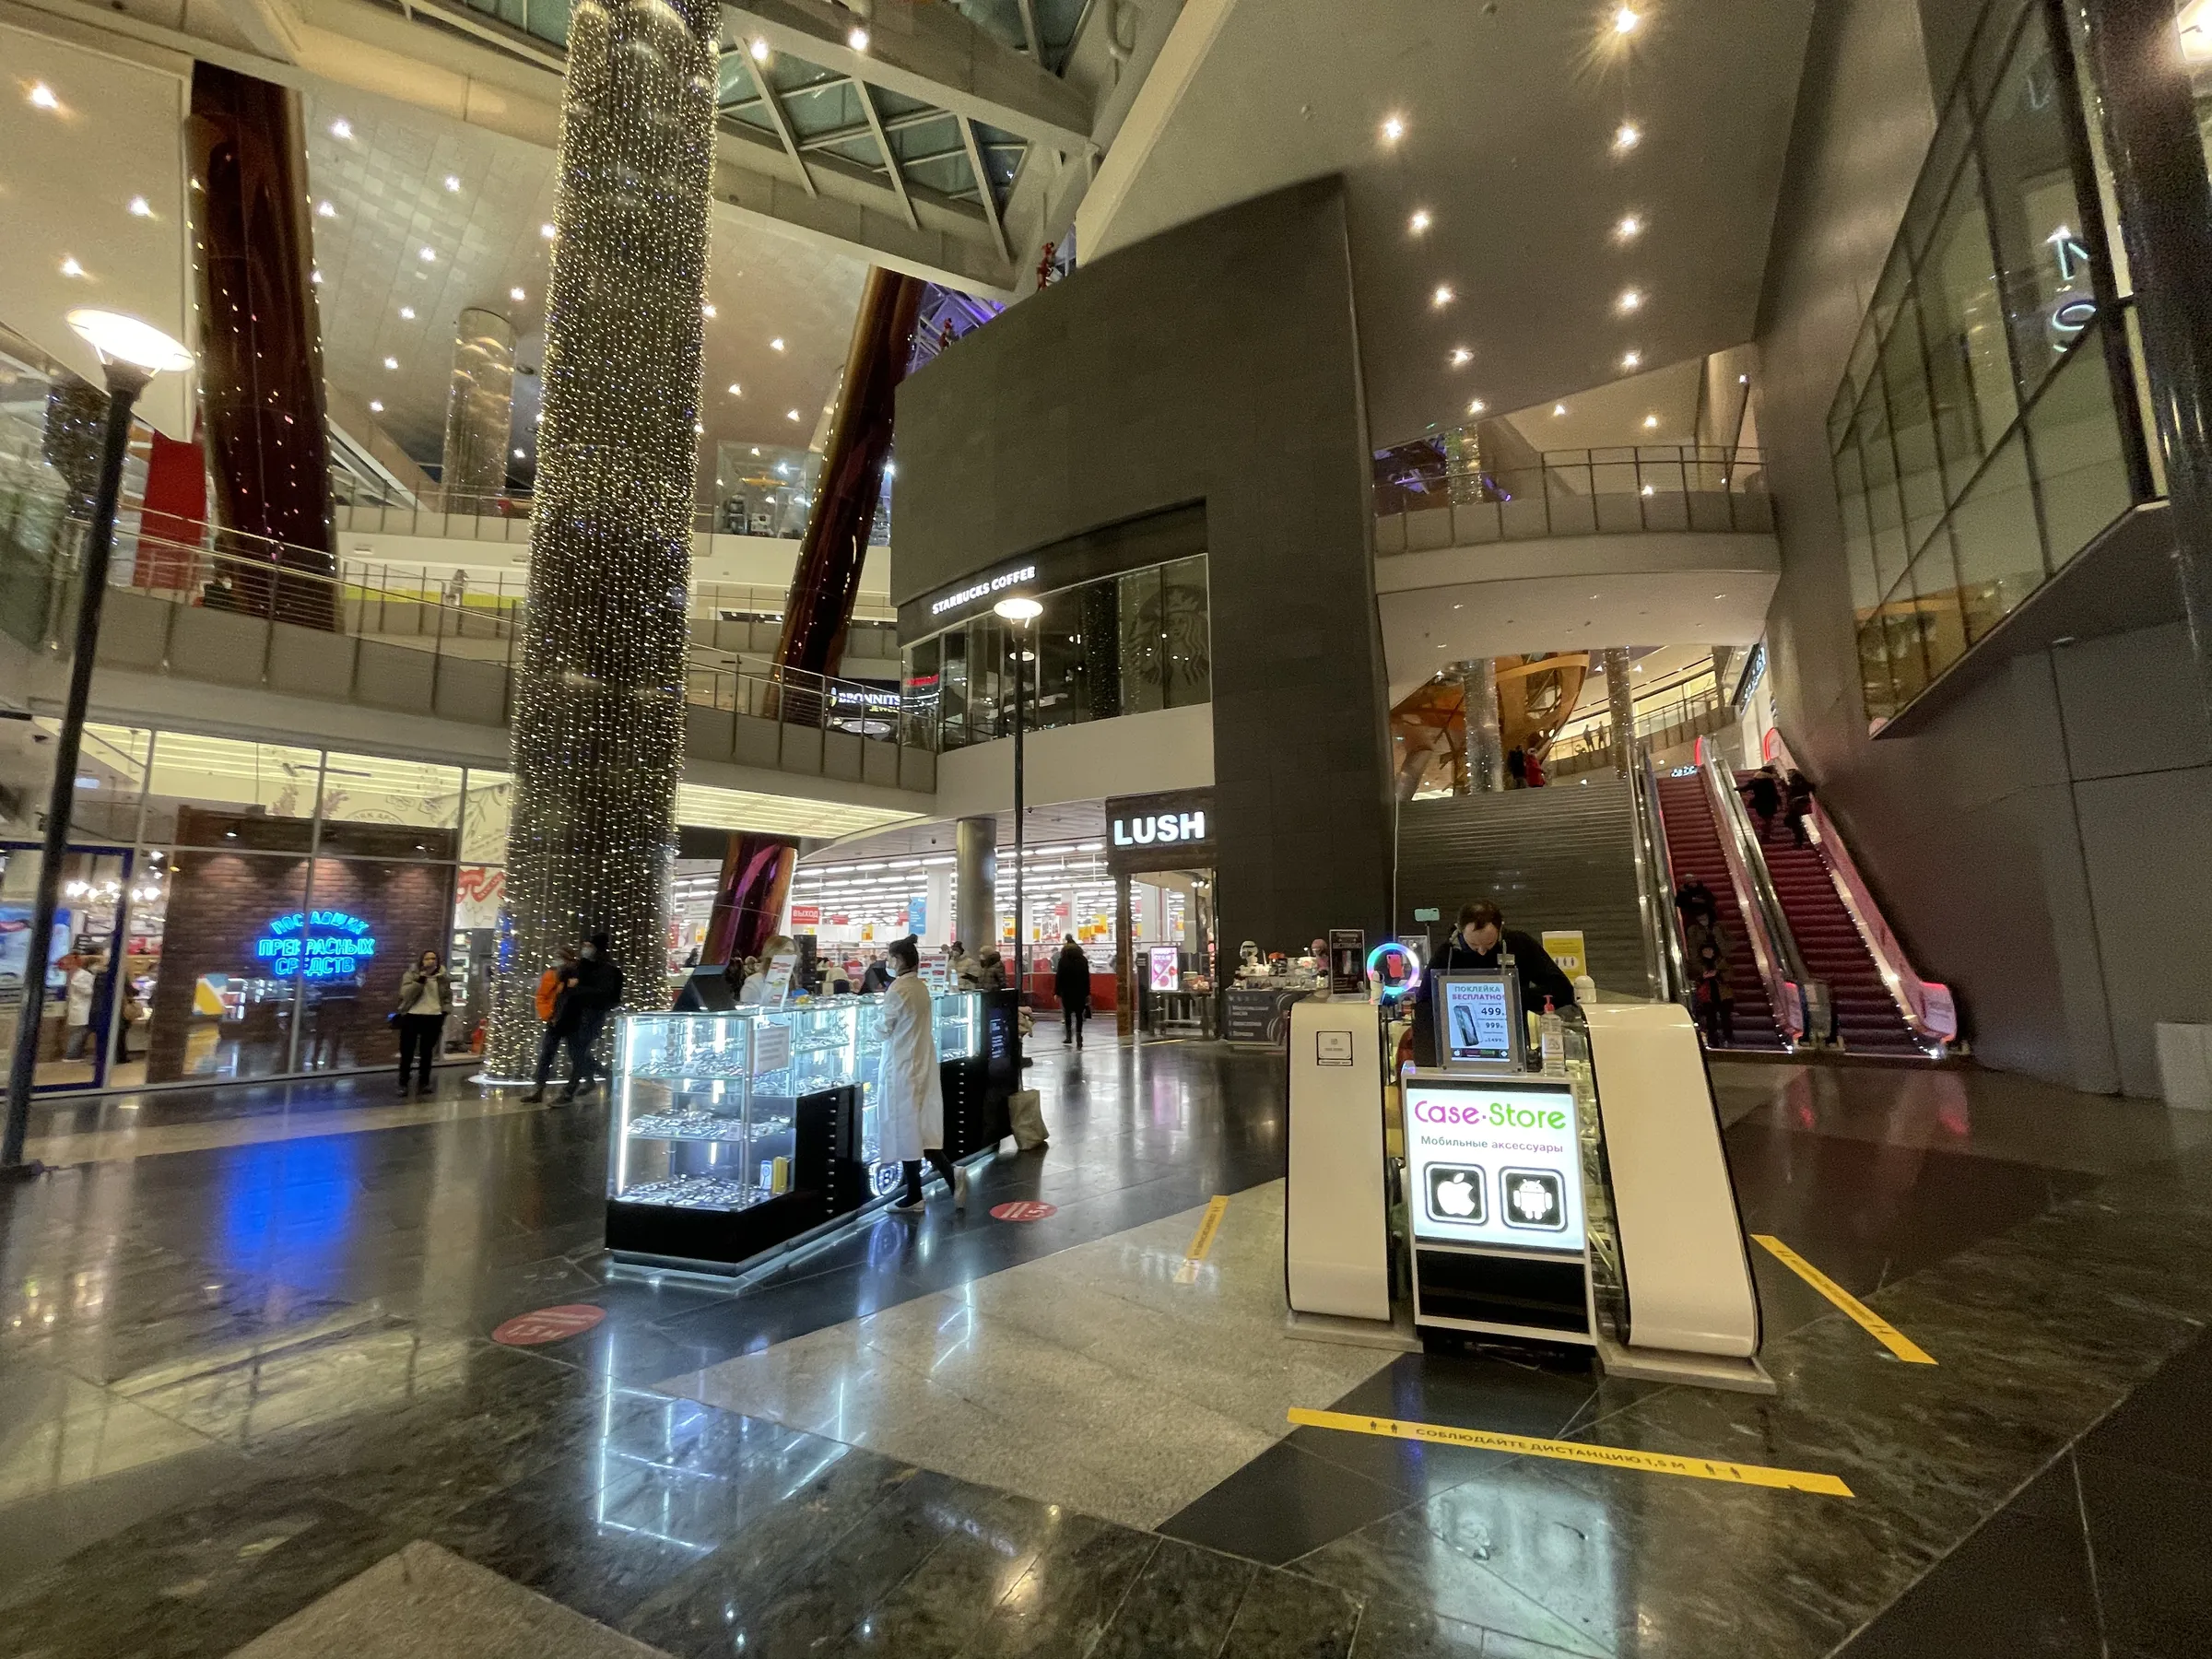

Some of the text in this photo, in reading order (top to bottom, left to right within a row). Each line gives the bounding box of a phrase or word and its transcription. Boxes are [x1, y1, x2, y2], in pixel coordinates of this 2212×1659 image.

[932, 566, 1036, 615] STARBUCKS COFFEE
[1113, 811, 1206, 846] LUSH
[270, 911, 369, 935] ПОСАВЩИК
[792, 909, 818, 919] ВЫХОД
[258, 938, 375, 957] ПРЕКРАСНЫХ
[1421, 1136, 1563, 1153] Мобильные аксессуары
[1416, 1429, 1526, 1449] СОБЛЮДАЙТЕ
[1530, 1443, 1641, 1464] ДИСТАНЦИЮ
